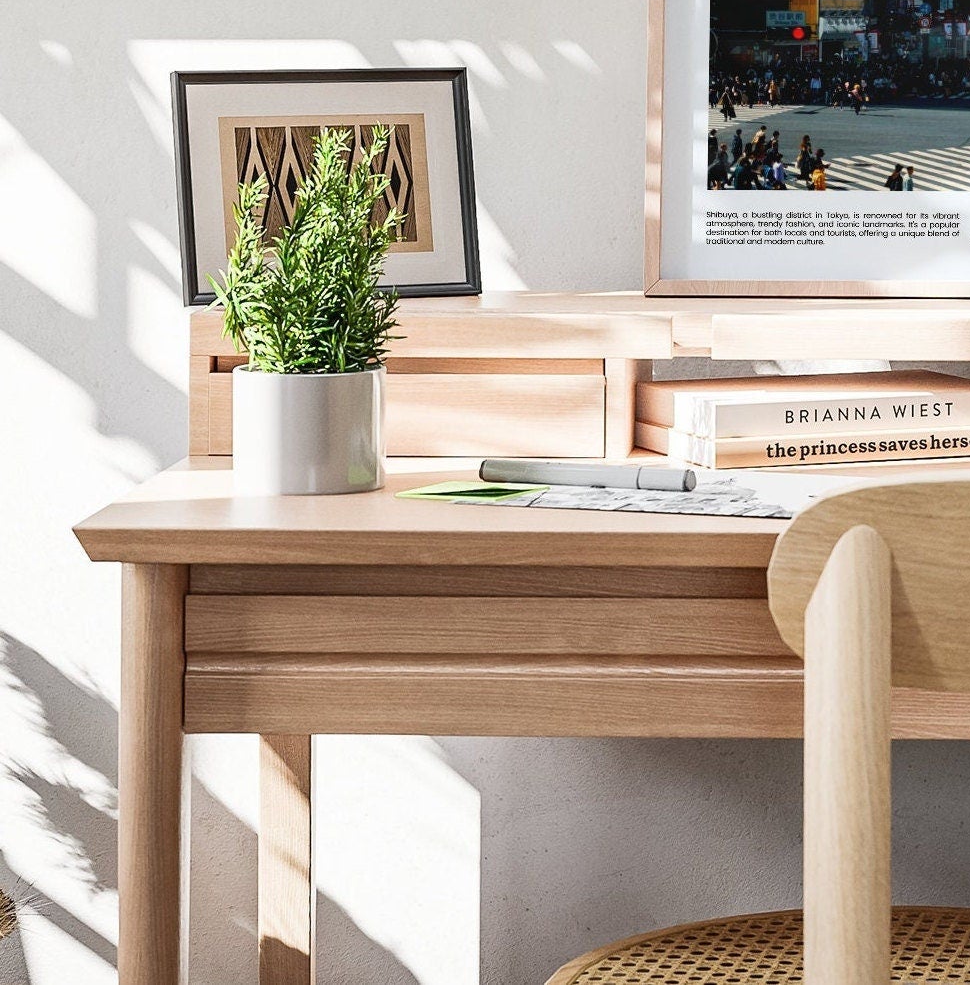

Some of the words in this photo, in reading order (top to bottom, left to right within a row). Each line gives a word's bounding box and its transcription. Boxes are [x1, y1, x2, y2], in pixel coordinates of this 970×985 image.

[785, 406, 881, 424] BRIANNA
[893, 402, 954, 419] WIEST
[766, 442, 797, 458] the
[799, 437, 876, 461] princess
[878, 438, 928, 452] saves
